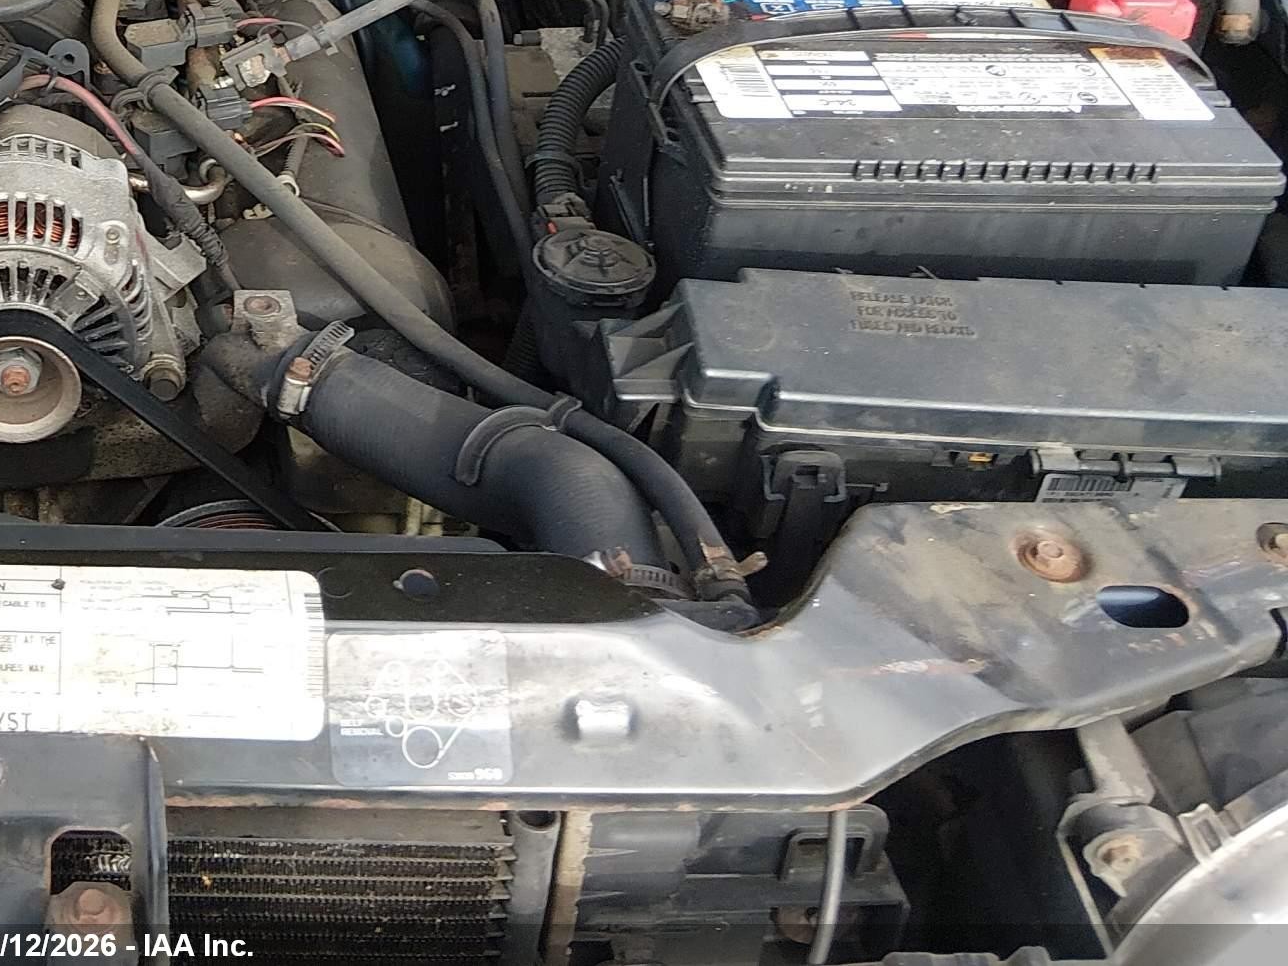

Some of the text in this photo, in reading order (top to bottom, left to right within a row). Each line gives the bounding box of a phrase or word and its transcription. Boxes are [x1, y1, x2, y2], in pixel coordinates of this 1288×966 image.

[857, 306, 883, 317] FOR
[937, 311, 957, 321] TO
[41, 636, 57, 645] THE
[29, 664, 45, 672] MAY
